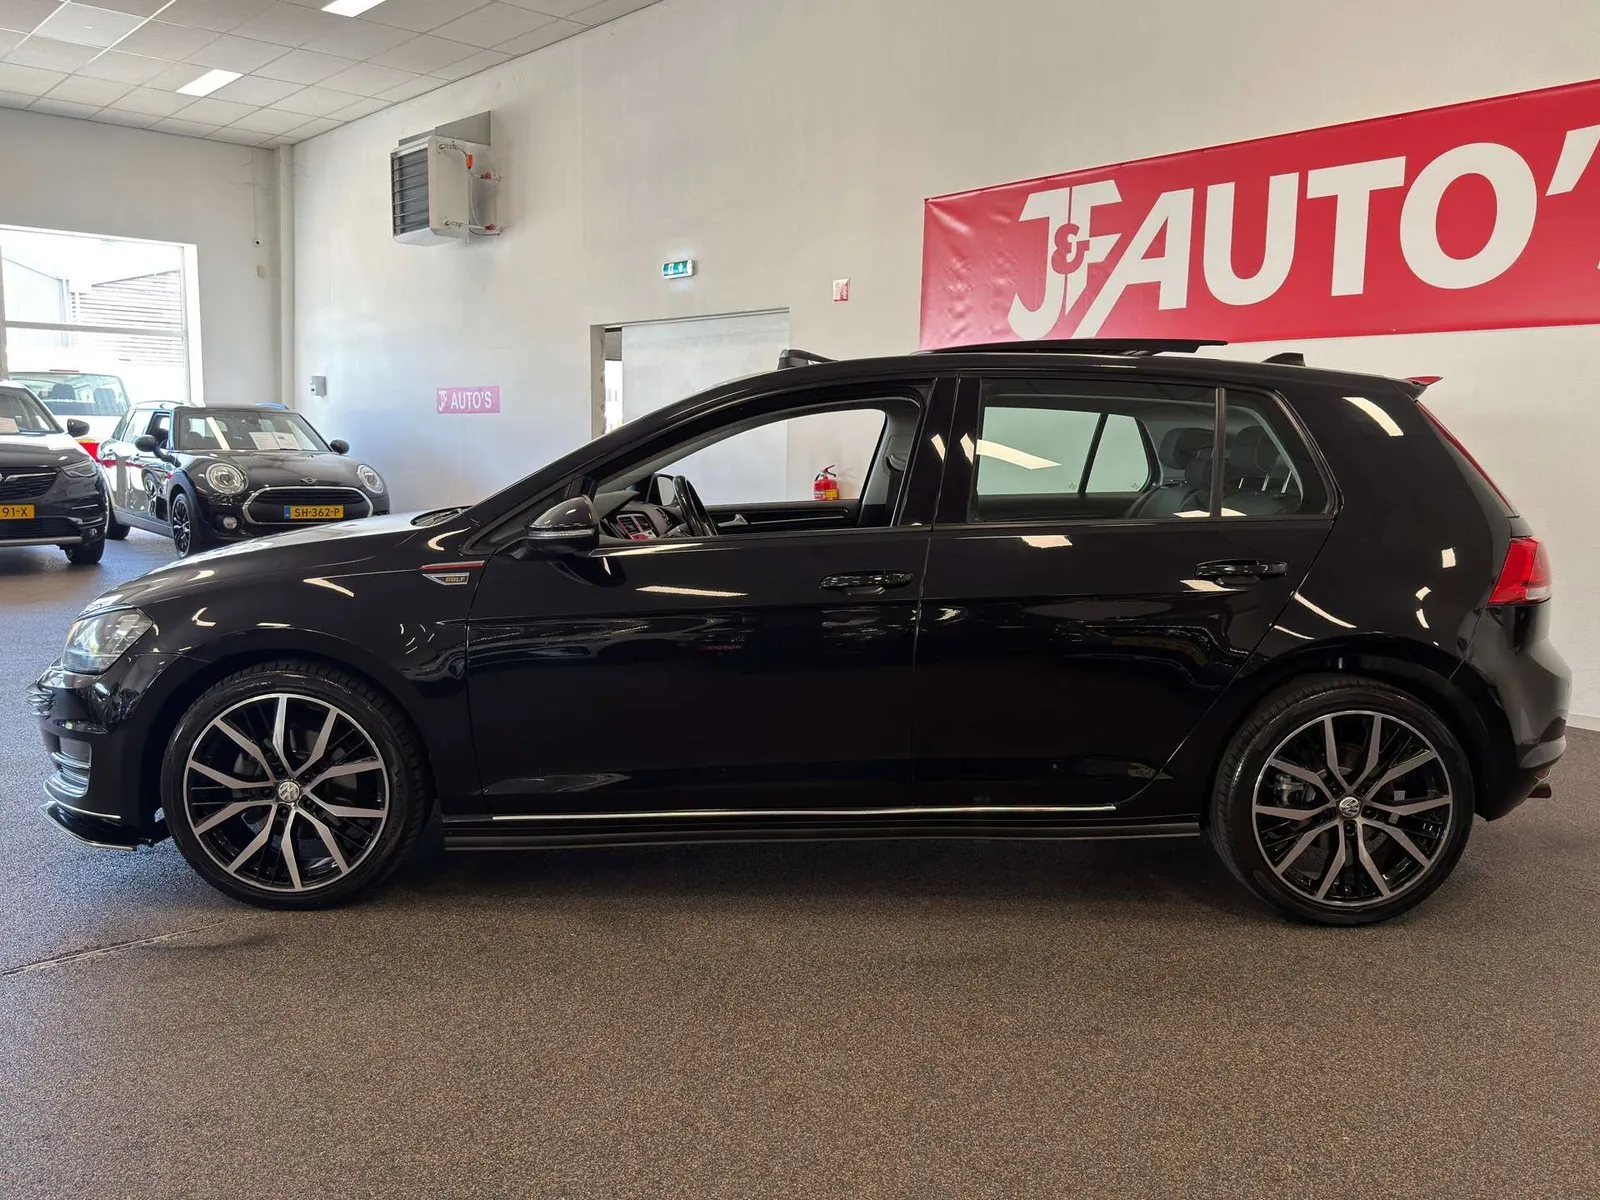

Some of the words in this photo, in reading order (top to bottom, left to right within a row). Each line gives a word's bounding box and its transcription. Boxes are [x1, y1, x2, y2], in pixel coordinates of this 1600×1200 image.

[1070, 124, 1600, 340] AUTO'
[450, 391, 492, 409] AUTO'S
[294, 507, 341, 517] SH-362-P
